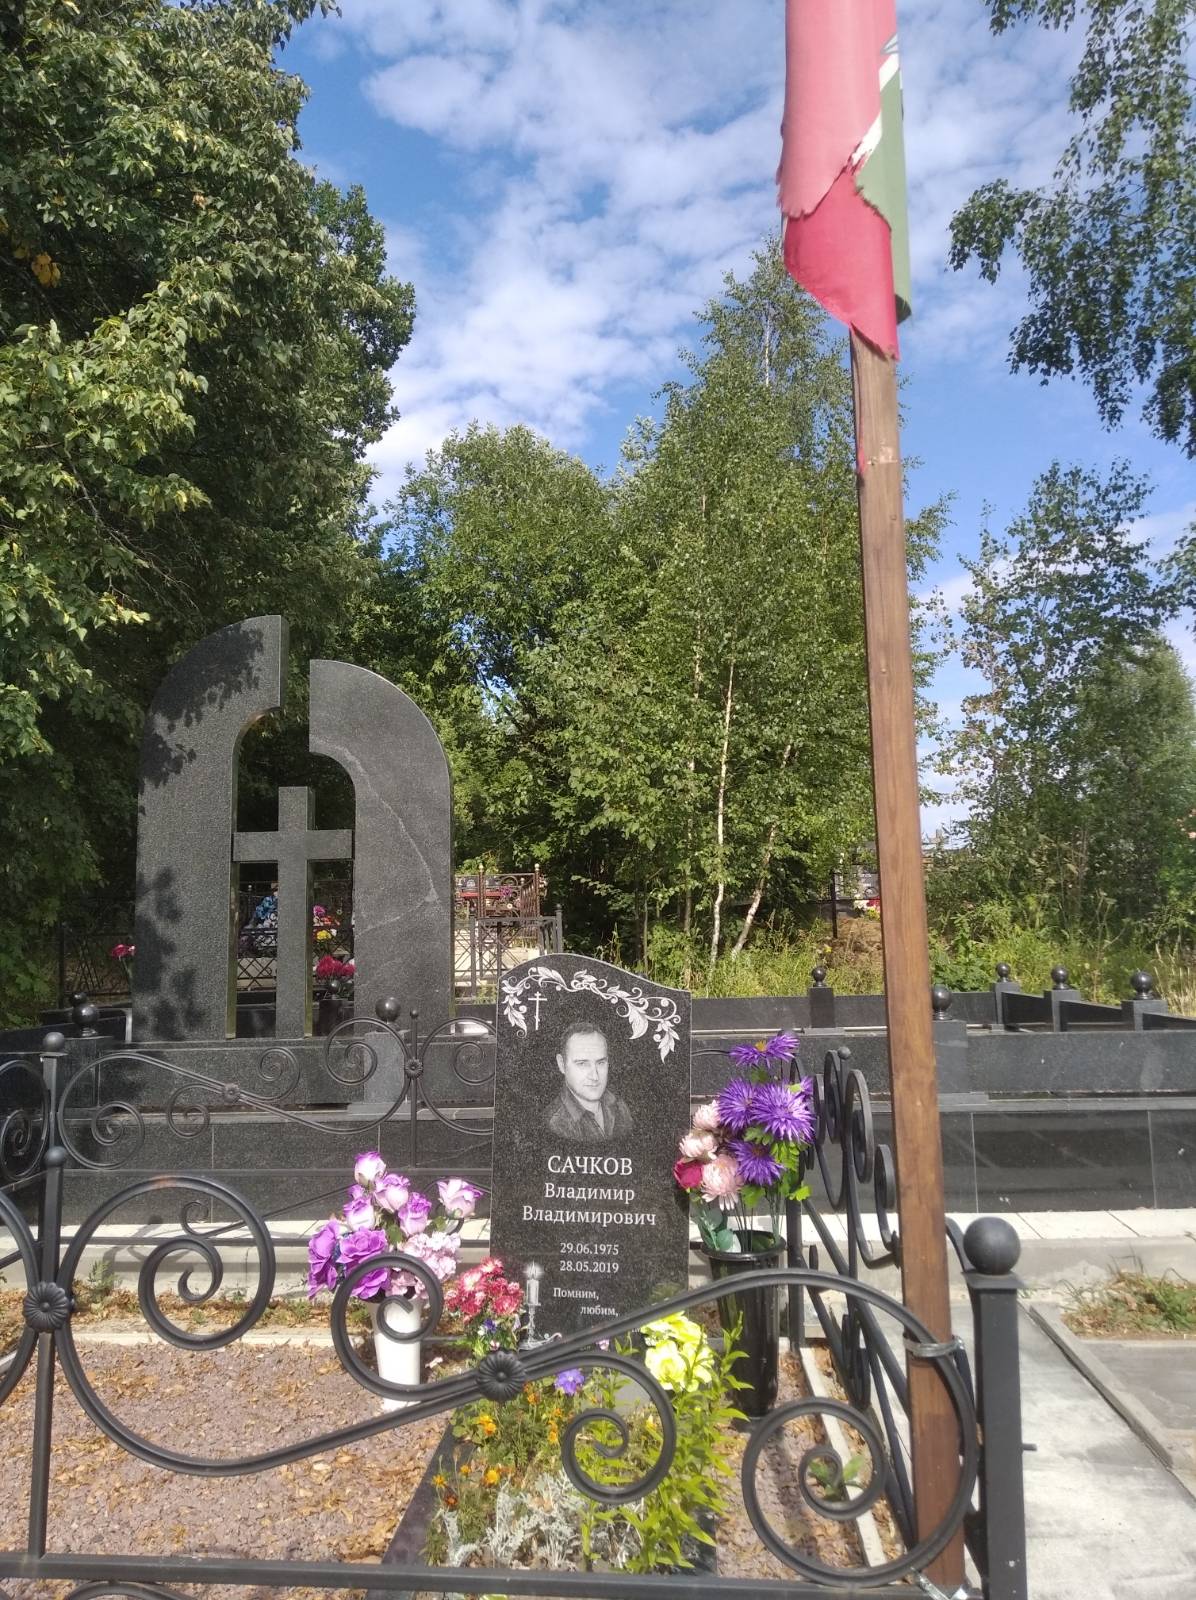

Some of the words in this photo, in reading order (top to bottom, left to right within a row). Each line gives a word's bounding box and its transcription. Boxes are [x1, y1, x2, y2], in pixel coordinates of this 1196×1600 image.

[547, 1155, 633, 1176] САЧКОВ
[544, 1182, 635, 1204] Владимир
[522, 1205, 657, 1227] Владимирович
[559, 1242, 620, 1256] 29.06.1975
[559, 1260, 620, 1274] 28.05.2019
[553, 1287, 600, 1301] Помним,
[580, 1305, 620, 1317] любим,
